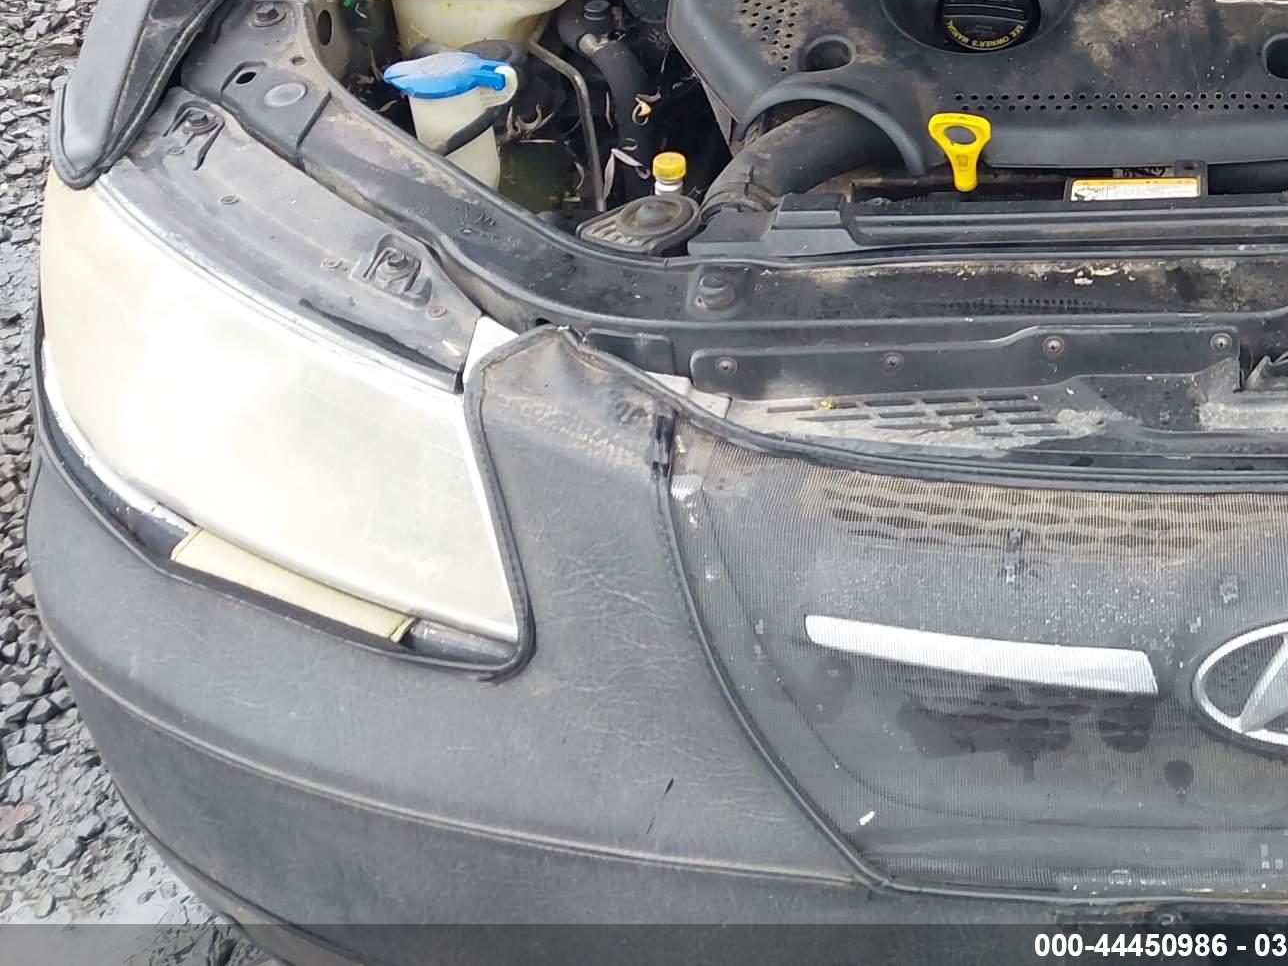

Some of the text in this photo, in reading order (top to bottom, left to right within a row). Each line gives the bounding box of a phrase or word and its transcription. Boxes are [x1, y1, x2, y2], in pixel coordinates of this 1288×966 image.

[945, 20, 1024, 48] SEE OWNER'S MANUAL
